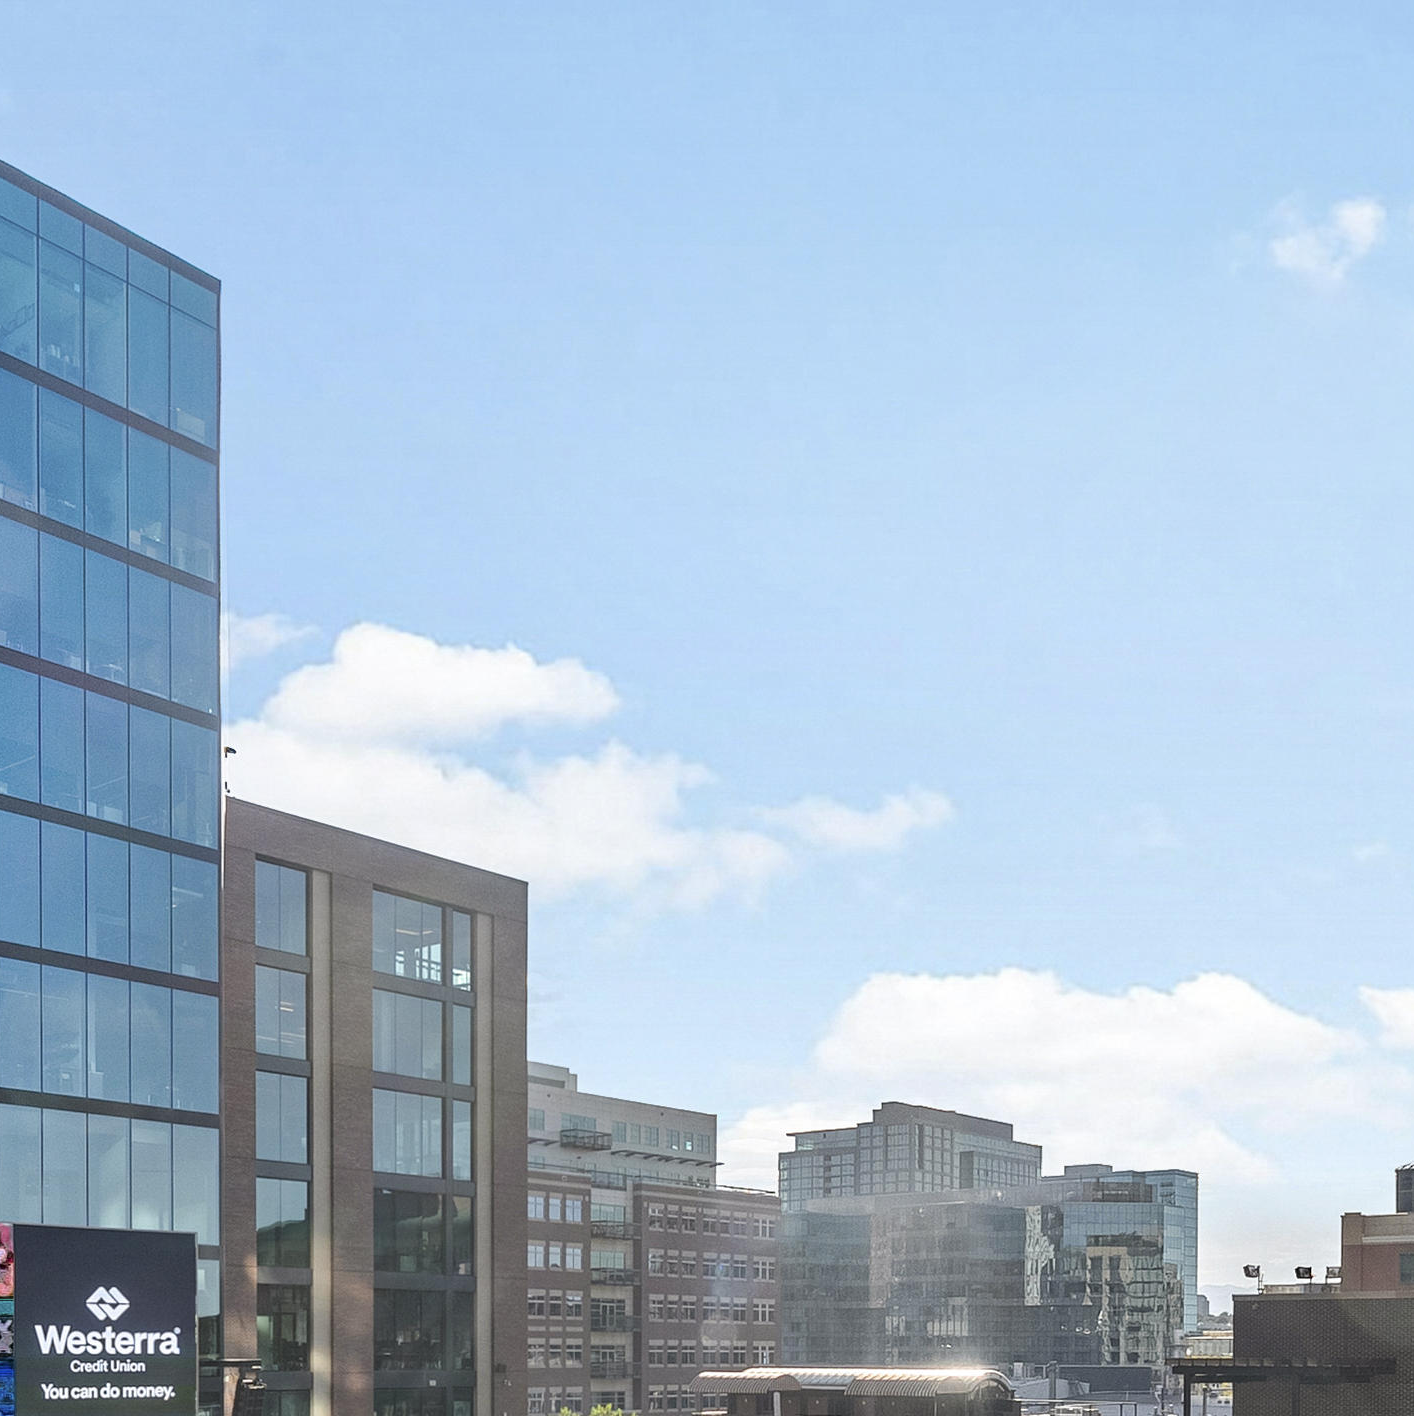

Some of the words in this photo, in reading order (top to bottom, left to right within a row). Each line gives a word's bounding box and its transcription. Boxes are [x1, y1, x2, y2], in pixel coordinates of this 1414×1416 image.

[34, 1325, 182, 1355] Westerra
[70, 1359, 109, 1373] Credit
[111, 1359, 146, 1373] Union
[41, 1383, 69, 1400] You
[71, 1386, 99, 1399] can
[100, 1382, 120, 1398] do
[122, 1385, 176, 1401] money.
